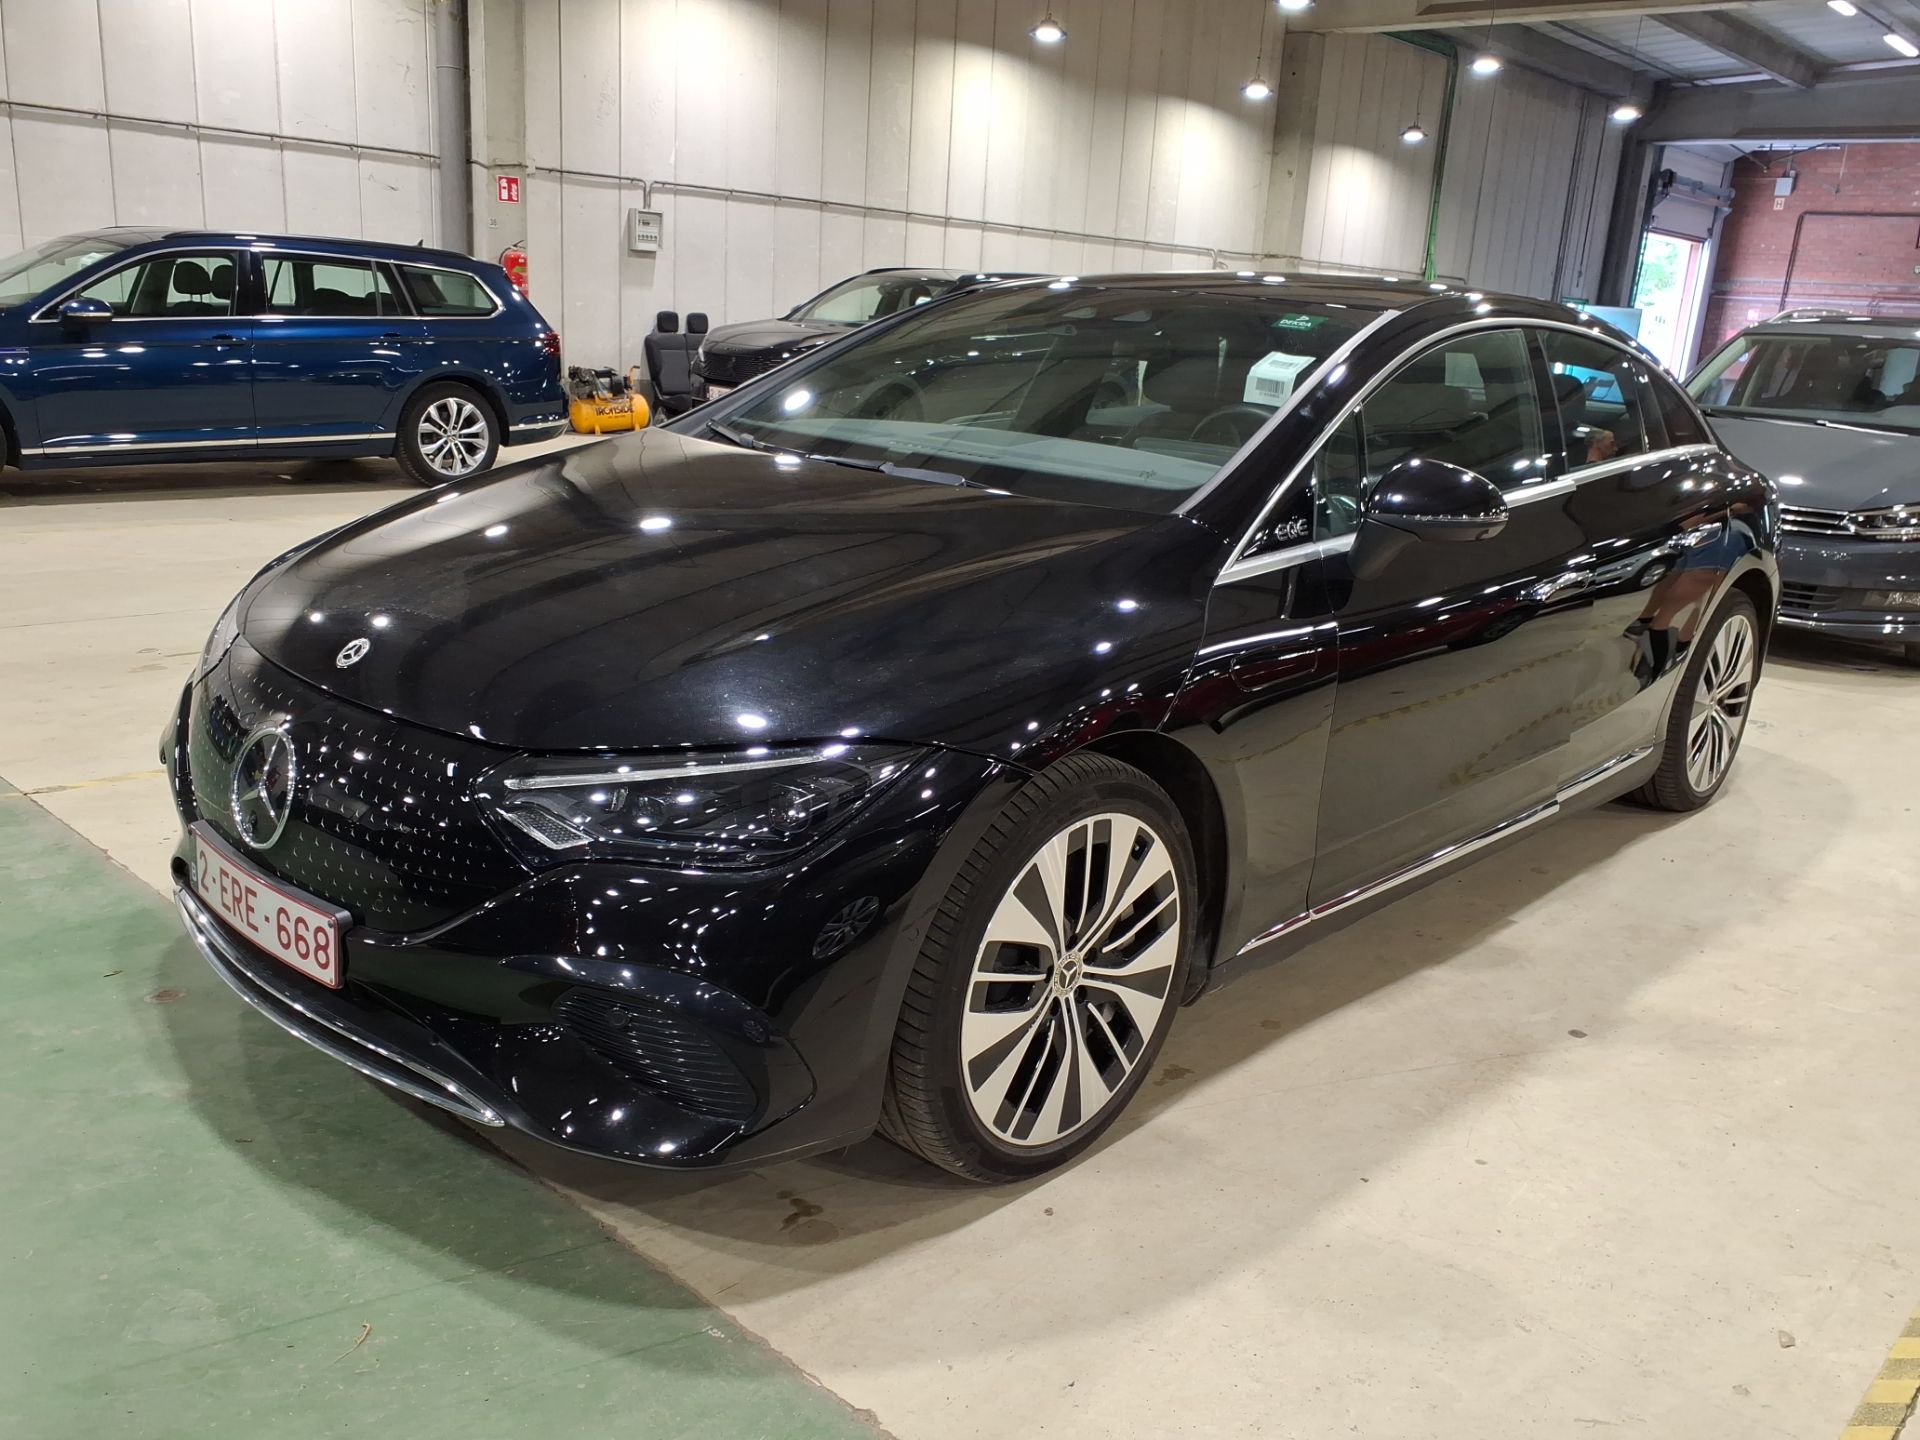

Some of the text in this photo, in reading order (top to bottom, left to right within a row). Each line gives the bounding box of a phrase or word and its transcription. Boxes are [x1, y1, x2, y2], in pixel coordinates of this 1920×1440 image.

[1279, 319, 1311, 327] DEKRA
[1276, 518, 1308, 541] EQE
[200, 850, 330, 970] 2-ERE-668
